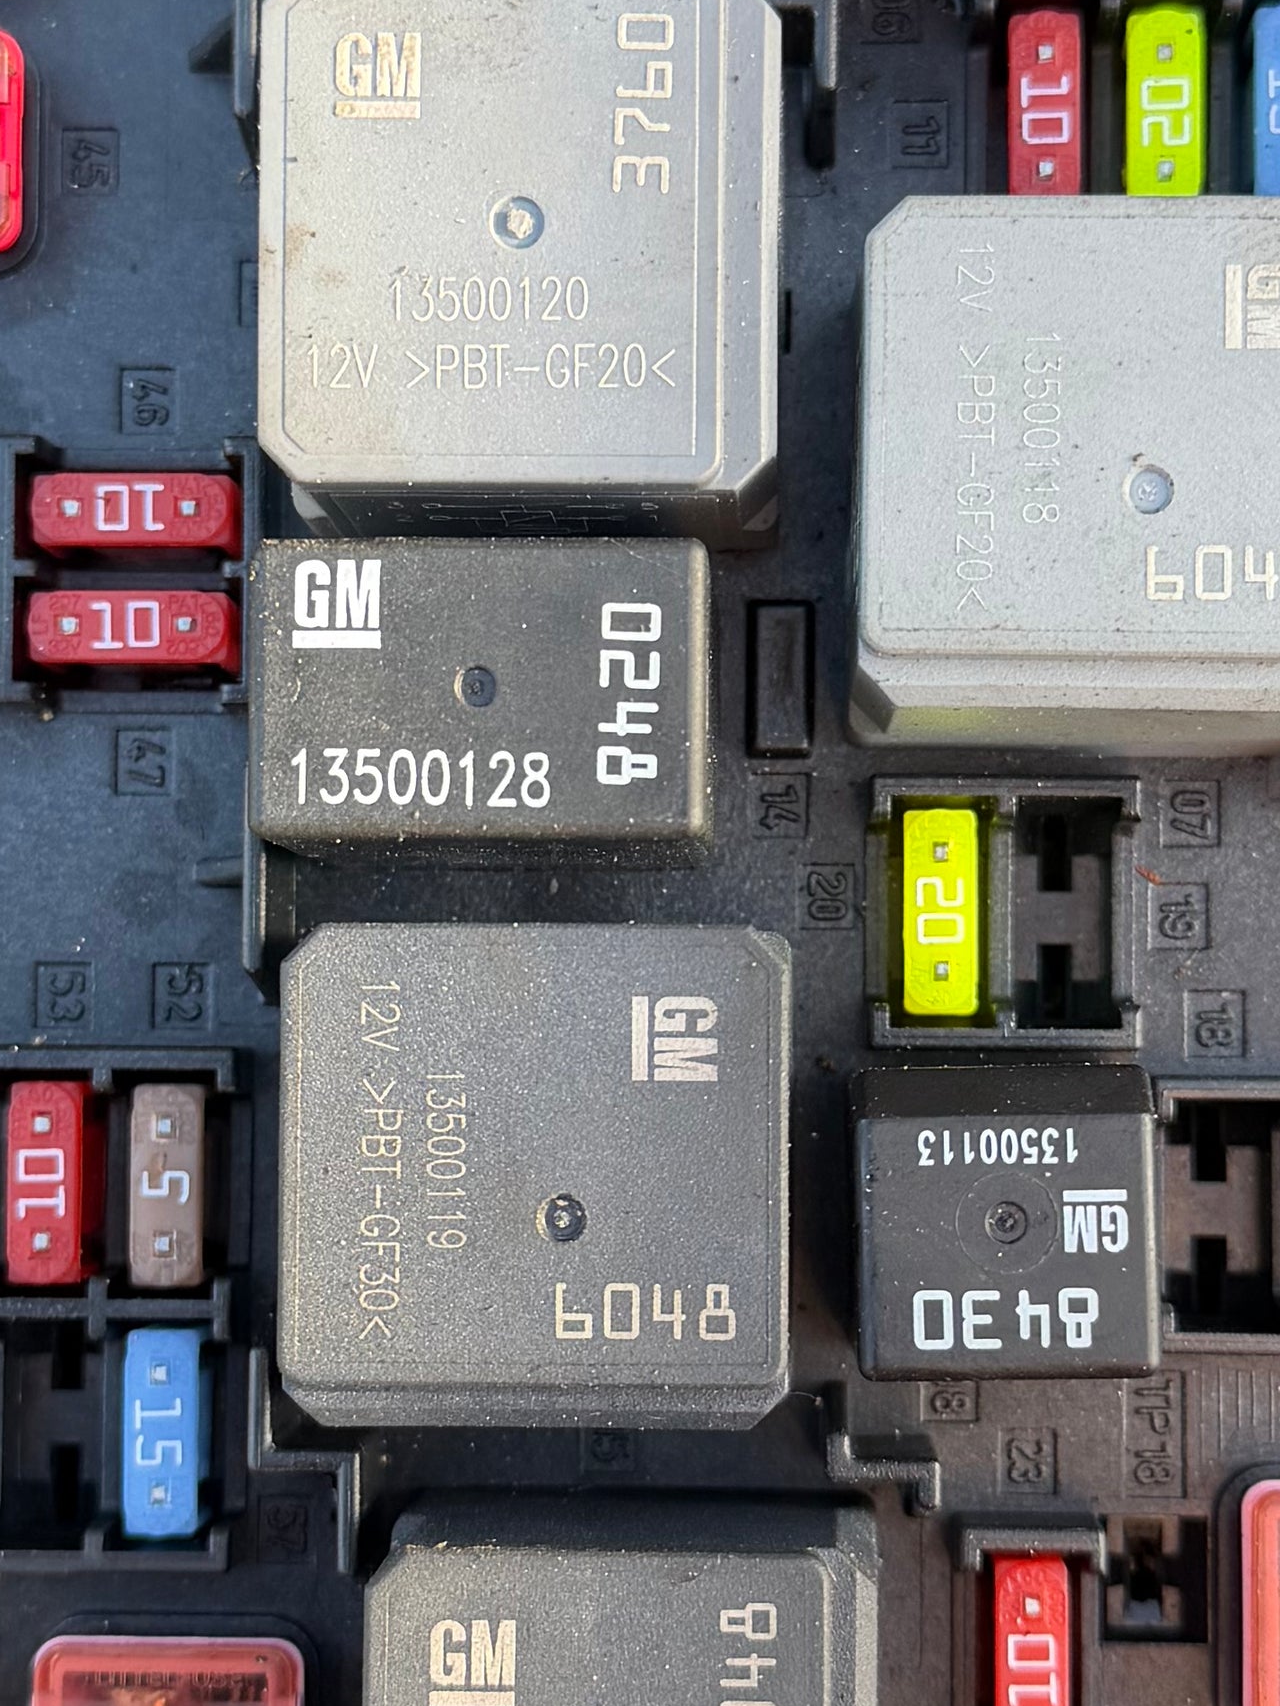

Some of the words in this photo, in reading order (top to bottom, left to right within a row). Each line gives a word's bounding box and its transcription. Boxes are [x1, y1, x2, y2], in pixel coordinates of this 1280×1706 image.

[335, 33, 421, 98] GM
[613, 14, 675, 194] 3760
[1020, 74, 1070, 145] 10
[1141, 77, 1190, 148] 20
[390, 277, 589, 323] 13500120
[955, 242, 996, 313] 12V
[307, 343, 378, 389] 12V
[408, 346, 676, 390] >PBT-GF20<
[1022, 332, 1061, 524] 13500118
[94, 483, 165, 531] 10
[954, 344, 997, 612] >PBT-GF20<
[92, 601, 159, 649] 10
[294, 561, 381, 627] GM
[597, 604, 662, 786] 0248
[290, 751, 552, 807] 13500128
[917, 876, 966, 945] 20
[360, 980, 400, 1051] 12V
[654, 996, 718, 1081] GM
[426, 1072, 467, 1250] 13500119
[918, 1127, 1078, 1166] 13500113
[15, 1148, 66, 1219] 10
[141, 1171, 189, 1203] 5
[1062, 1204, 1129, 1253] GM
[555, 1283, 737, 1340] 6048
[912, 1289, 1100, 1351] 8430
[135, 1398, 181, 1465] 15
[430, 1619, 517, 1688] GM
